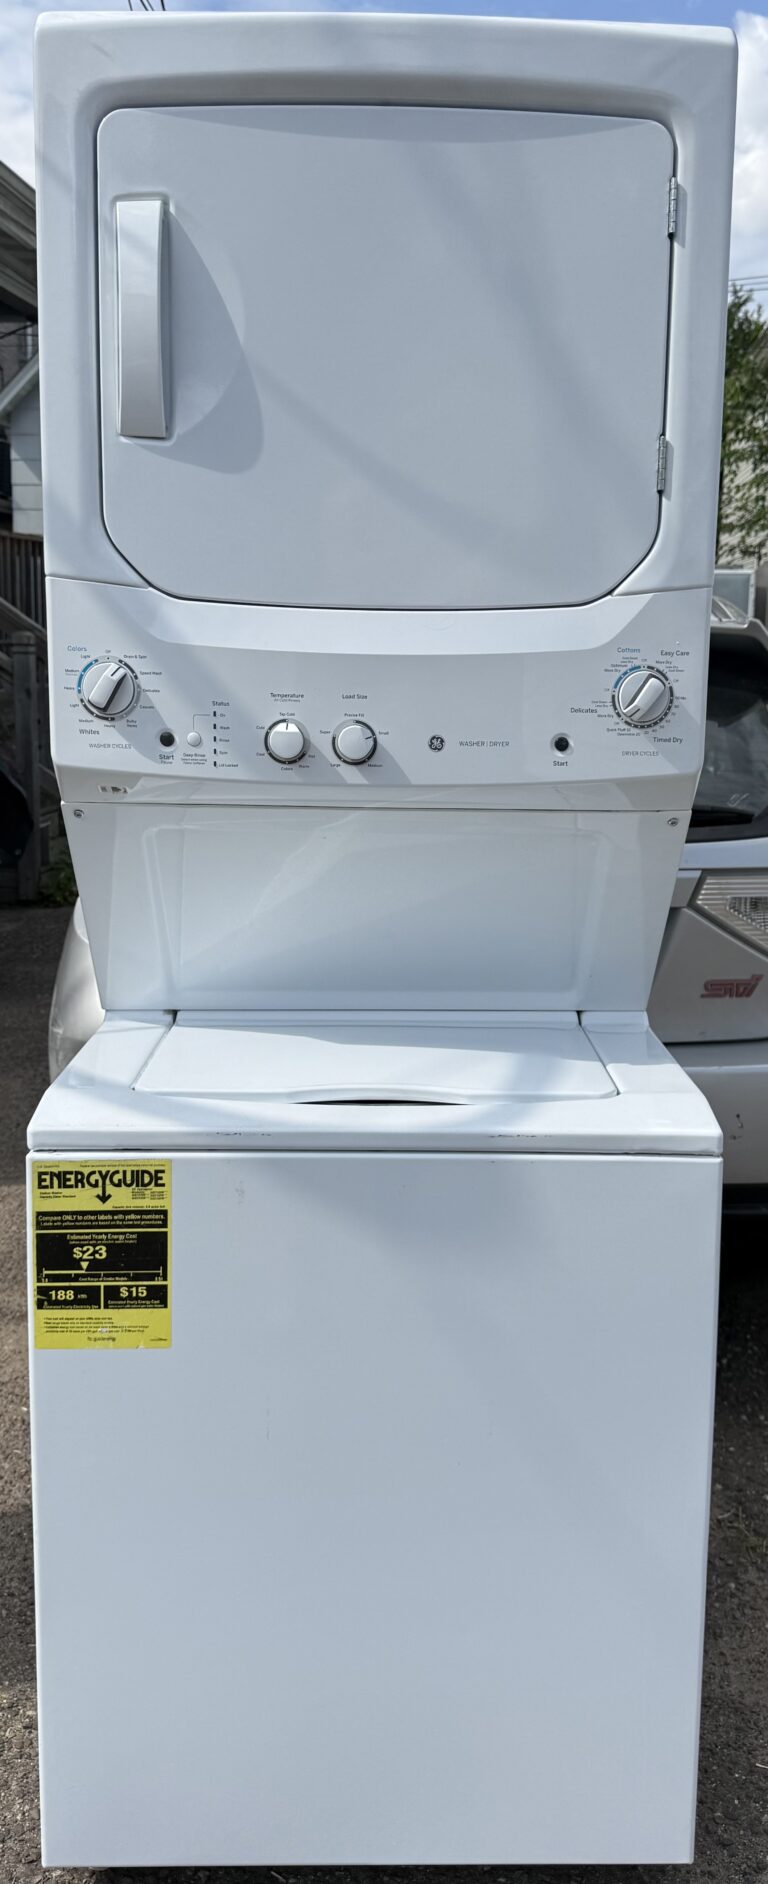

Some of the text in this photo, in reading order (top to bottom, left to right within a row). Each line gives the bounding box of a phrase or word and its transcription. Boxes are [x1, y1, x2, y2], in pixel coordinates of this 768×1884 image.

[37, 1169, 165, 1189] ENERGYGUIDE
[73, 1245, 107, 1260] $23
[49, 1290, 74, 1301] 188
[120, 1286, 147, 1299] $15
